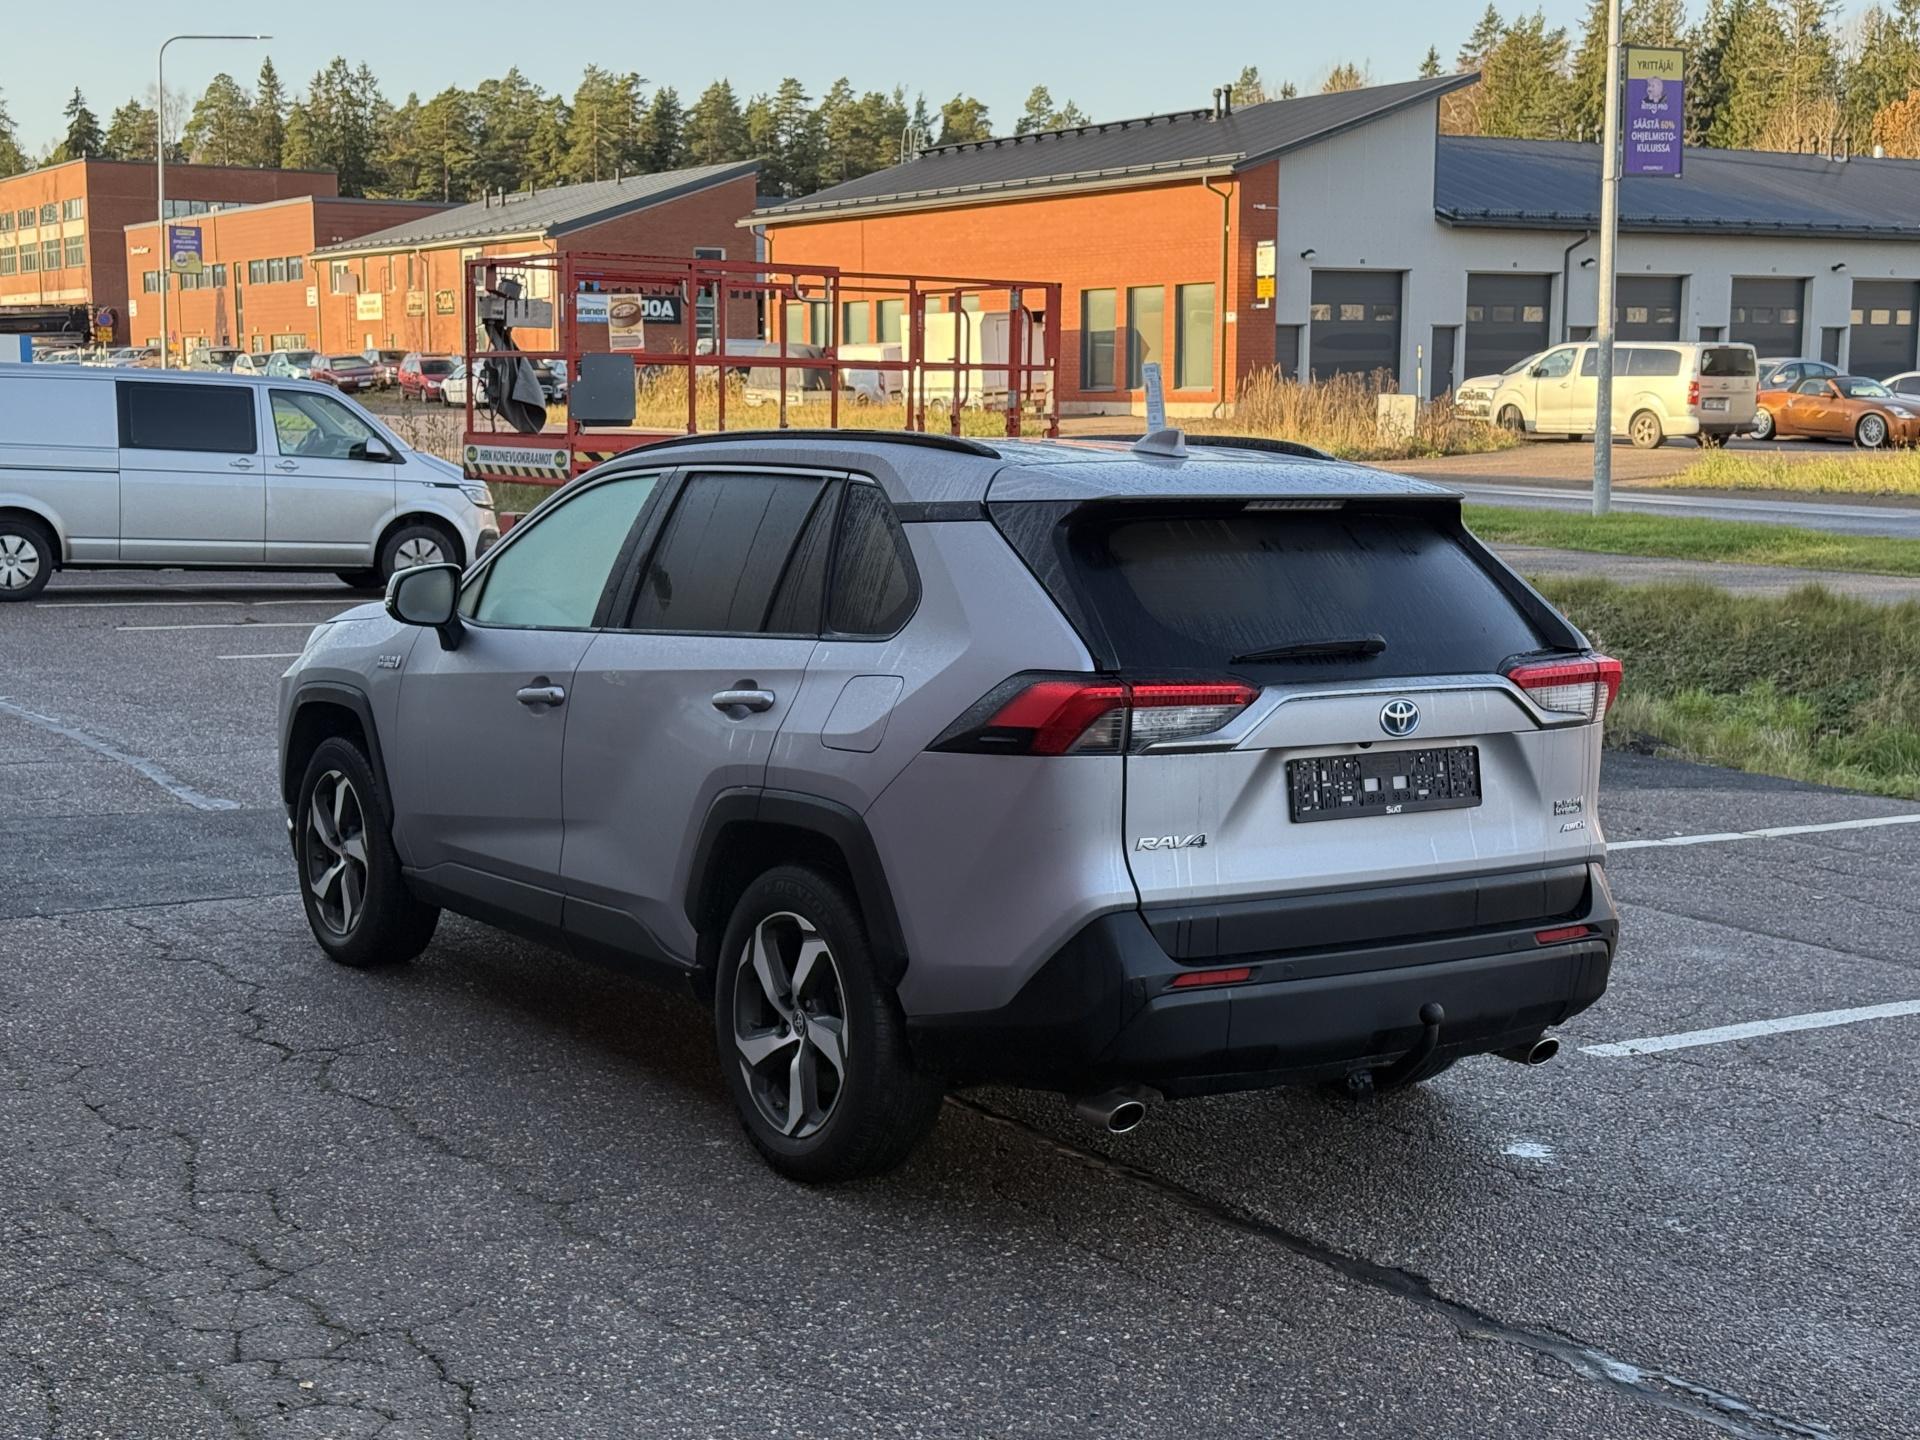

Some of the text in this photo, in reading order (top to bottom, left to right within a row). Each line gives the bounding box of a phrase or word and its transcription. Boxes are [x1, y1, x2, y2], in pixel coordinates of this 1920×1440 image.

[1637, 60, 1674, 72] YRITTÄJÄ!
[1633, 118, 1660, 129] SÄÄSTÄ
[1631, 131, 1677, 142] OHJELMISTO-
[1636, 143, 1671, 153] KULUISSA
[1135, 832, 1208, 851] RAV4
